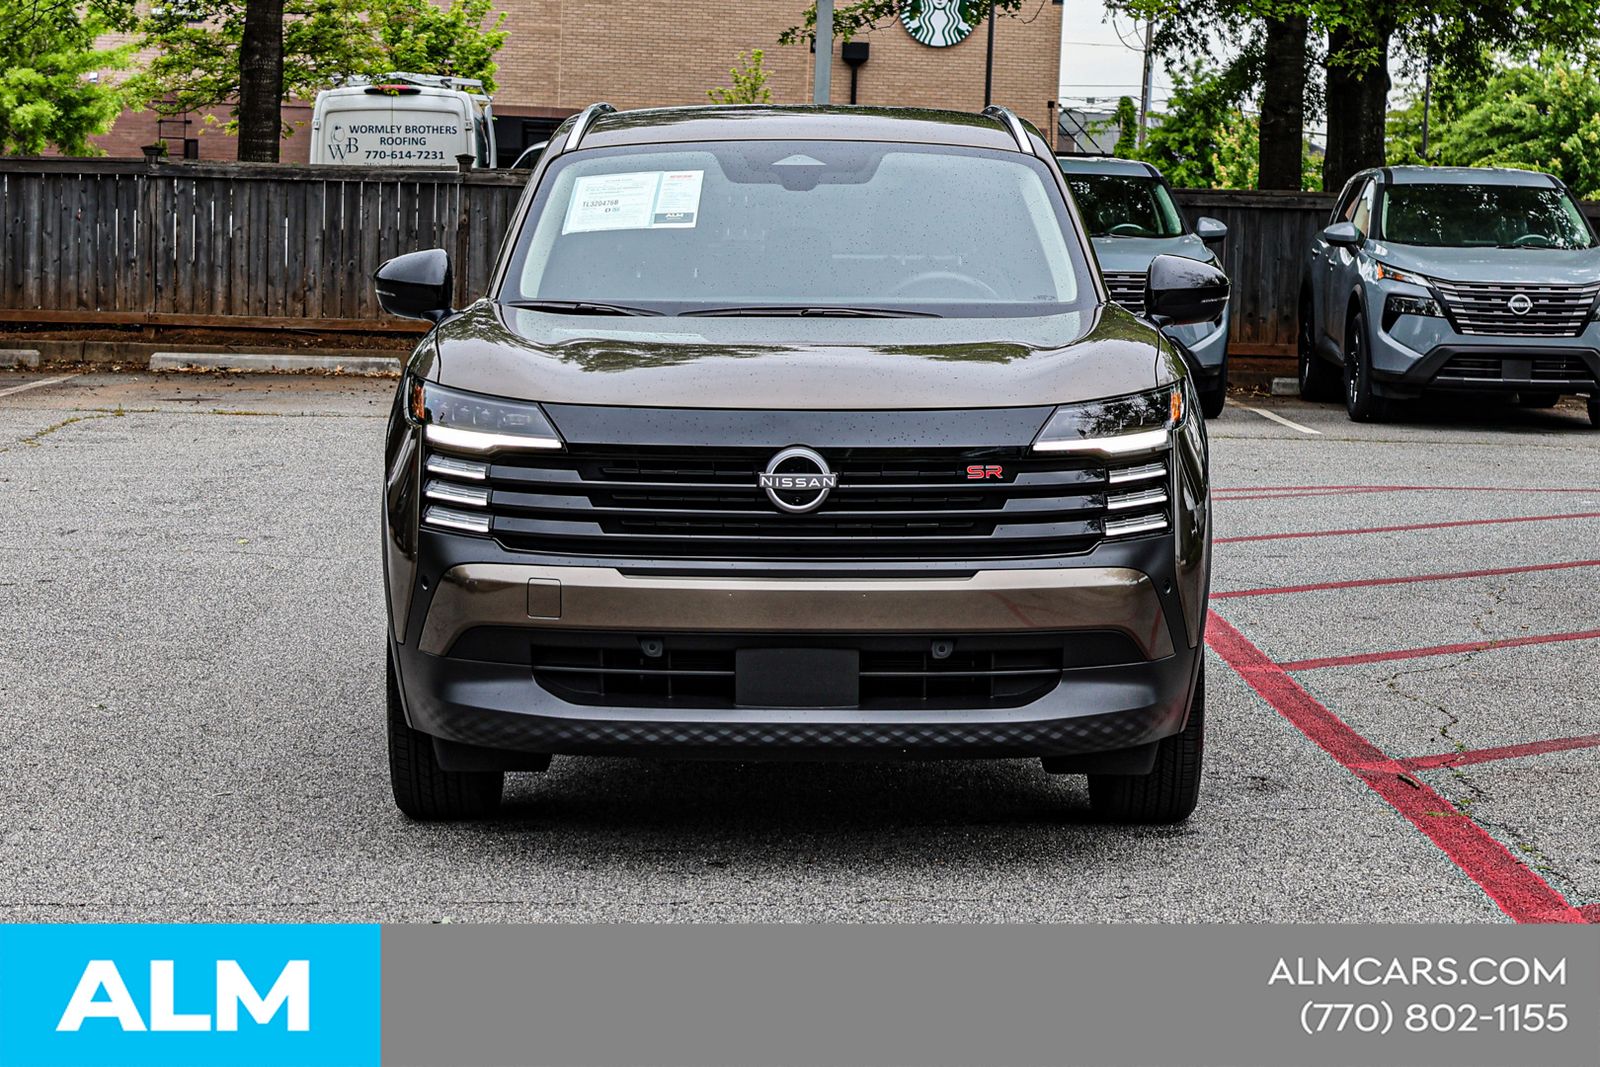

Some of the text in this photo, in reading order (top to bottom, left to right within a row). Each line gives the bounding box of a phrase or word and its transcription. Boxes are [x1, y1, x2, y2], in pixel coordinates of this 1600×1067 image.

[350, 125, 457, 134] WORMLEY BROTHERS
[380, 137, 427, 146] ROOFING
[365, 150, 445, 160] 770-614-7231
[966, 465, 1003, 479] SR
[761, 476, 836, 488] NISSAN
